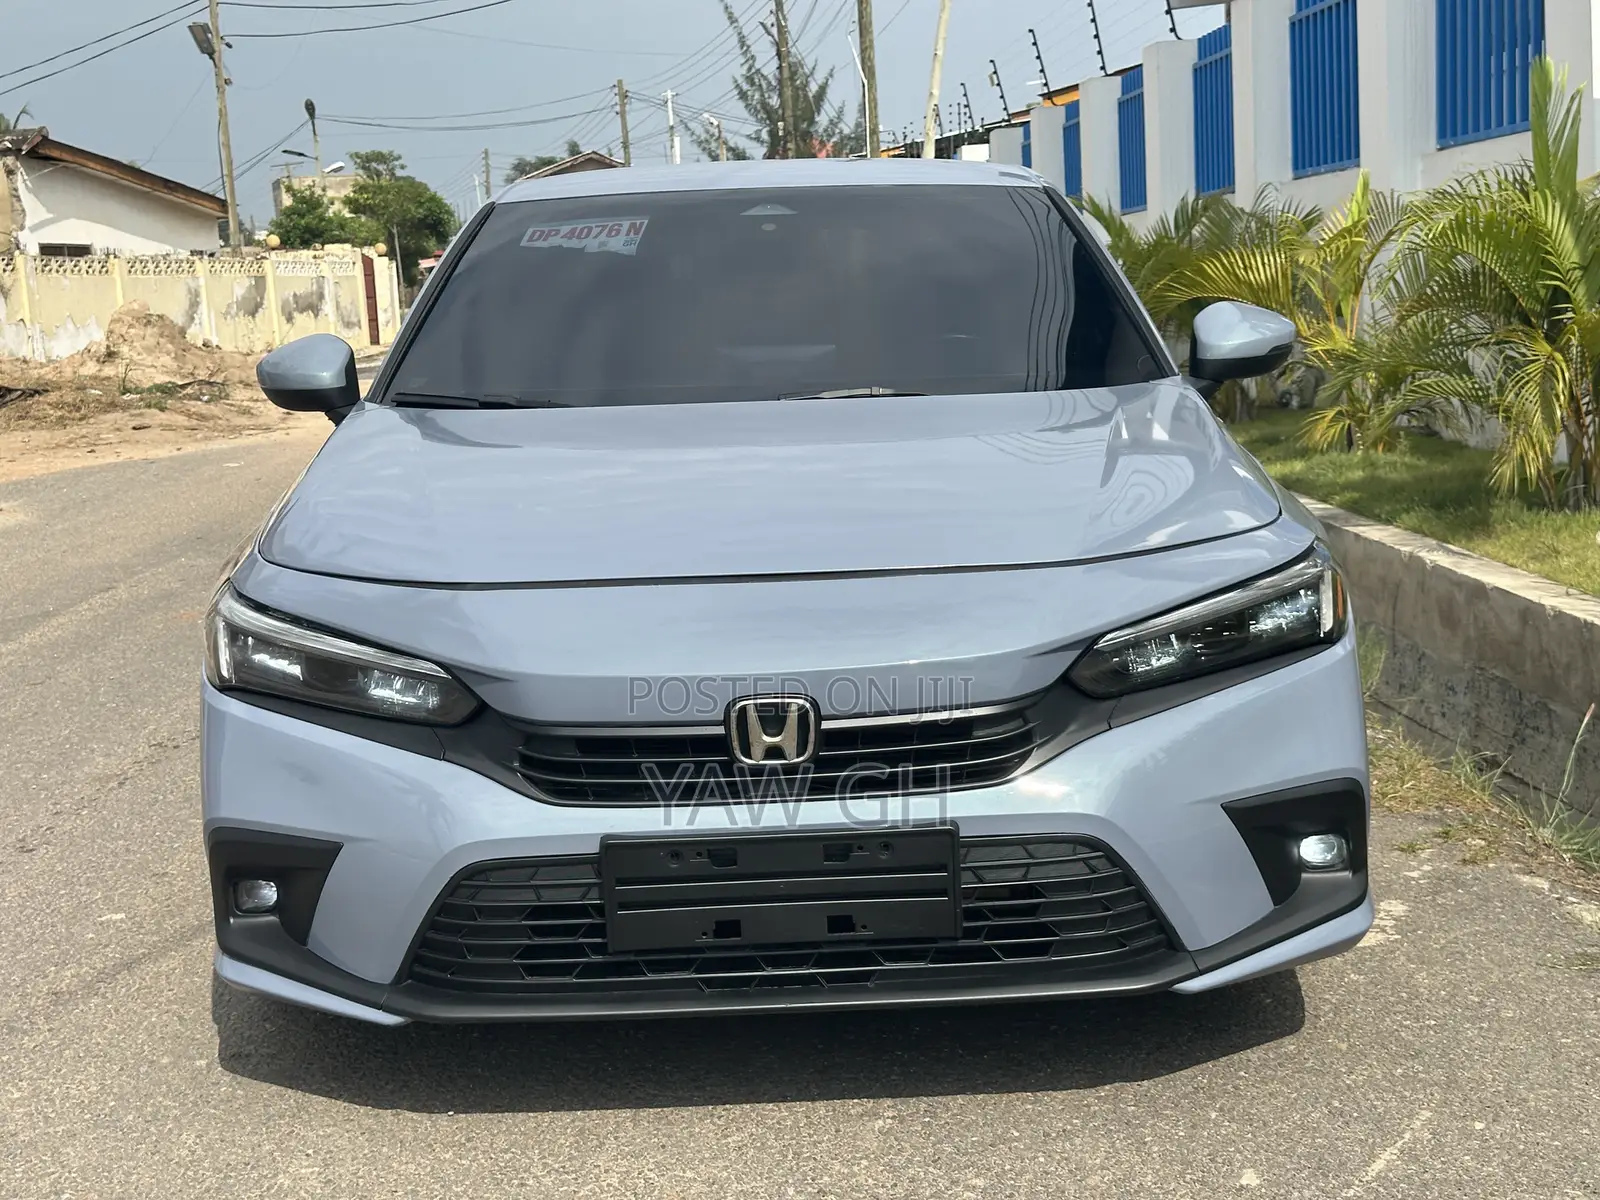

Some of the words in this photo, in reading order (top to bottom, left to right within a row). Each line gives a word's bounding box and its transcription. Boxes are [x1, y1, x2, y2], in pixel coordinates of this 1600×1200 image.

[526, 229, 560, 243] DP
[561, 223, 623, 240] 4076
[625, 221, 645, 237] N
